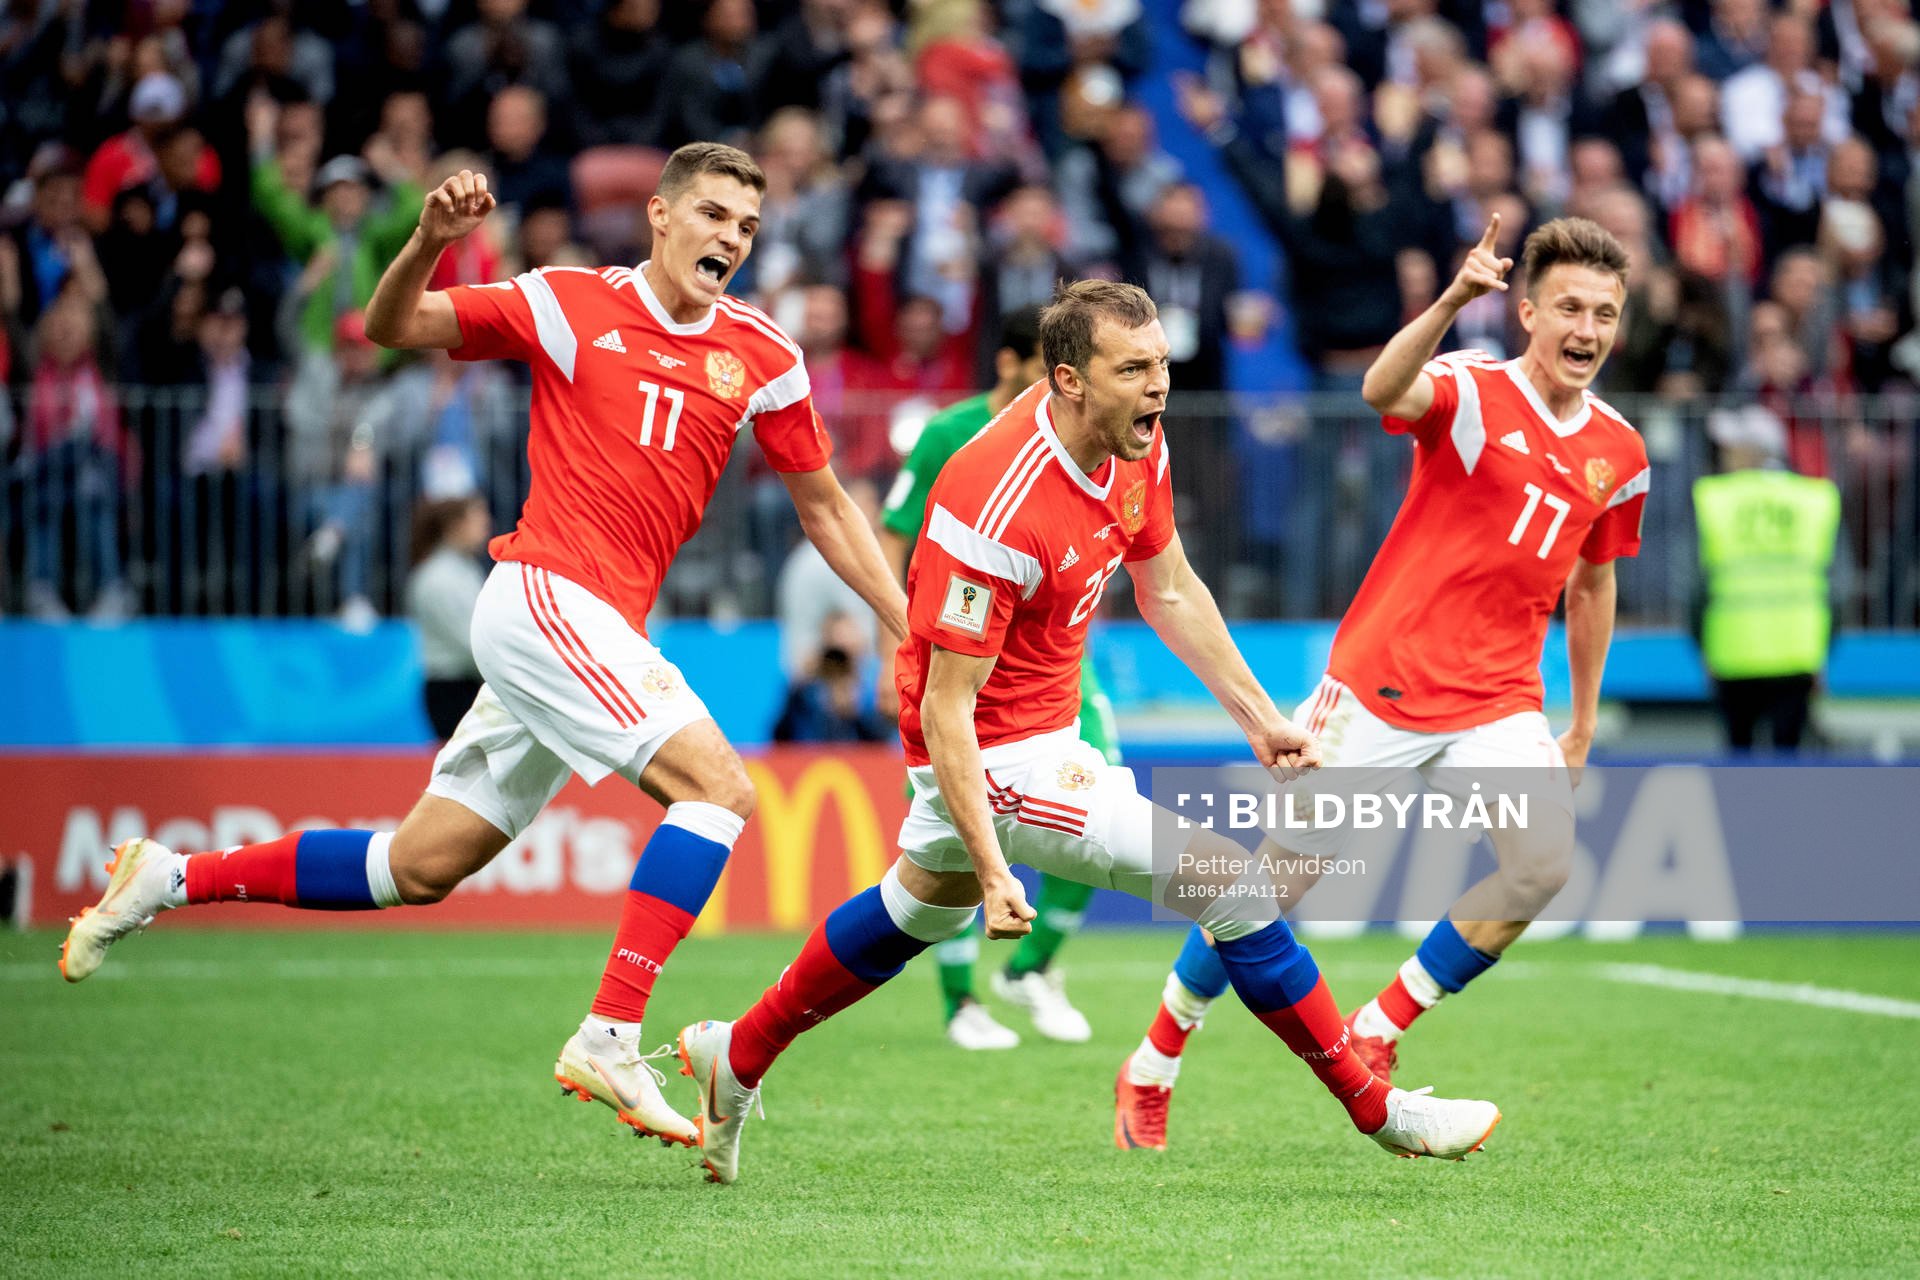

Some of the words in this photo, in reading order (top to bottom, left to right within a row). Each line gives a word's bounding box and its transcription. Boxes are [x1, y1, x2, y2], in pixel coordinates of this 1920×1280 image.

[638, 380, 685, 452] 11
[1507, 482, 1572, 560] 17
[1057, 554, 1081, 573] adidas
[1066, 551, 1124, 628] 22
